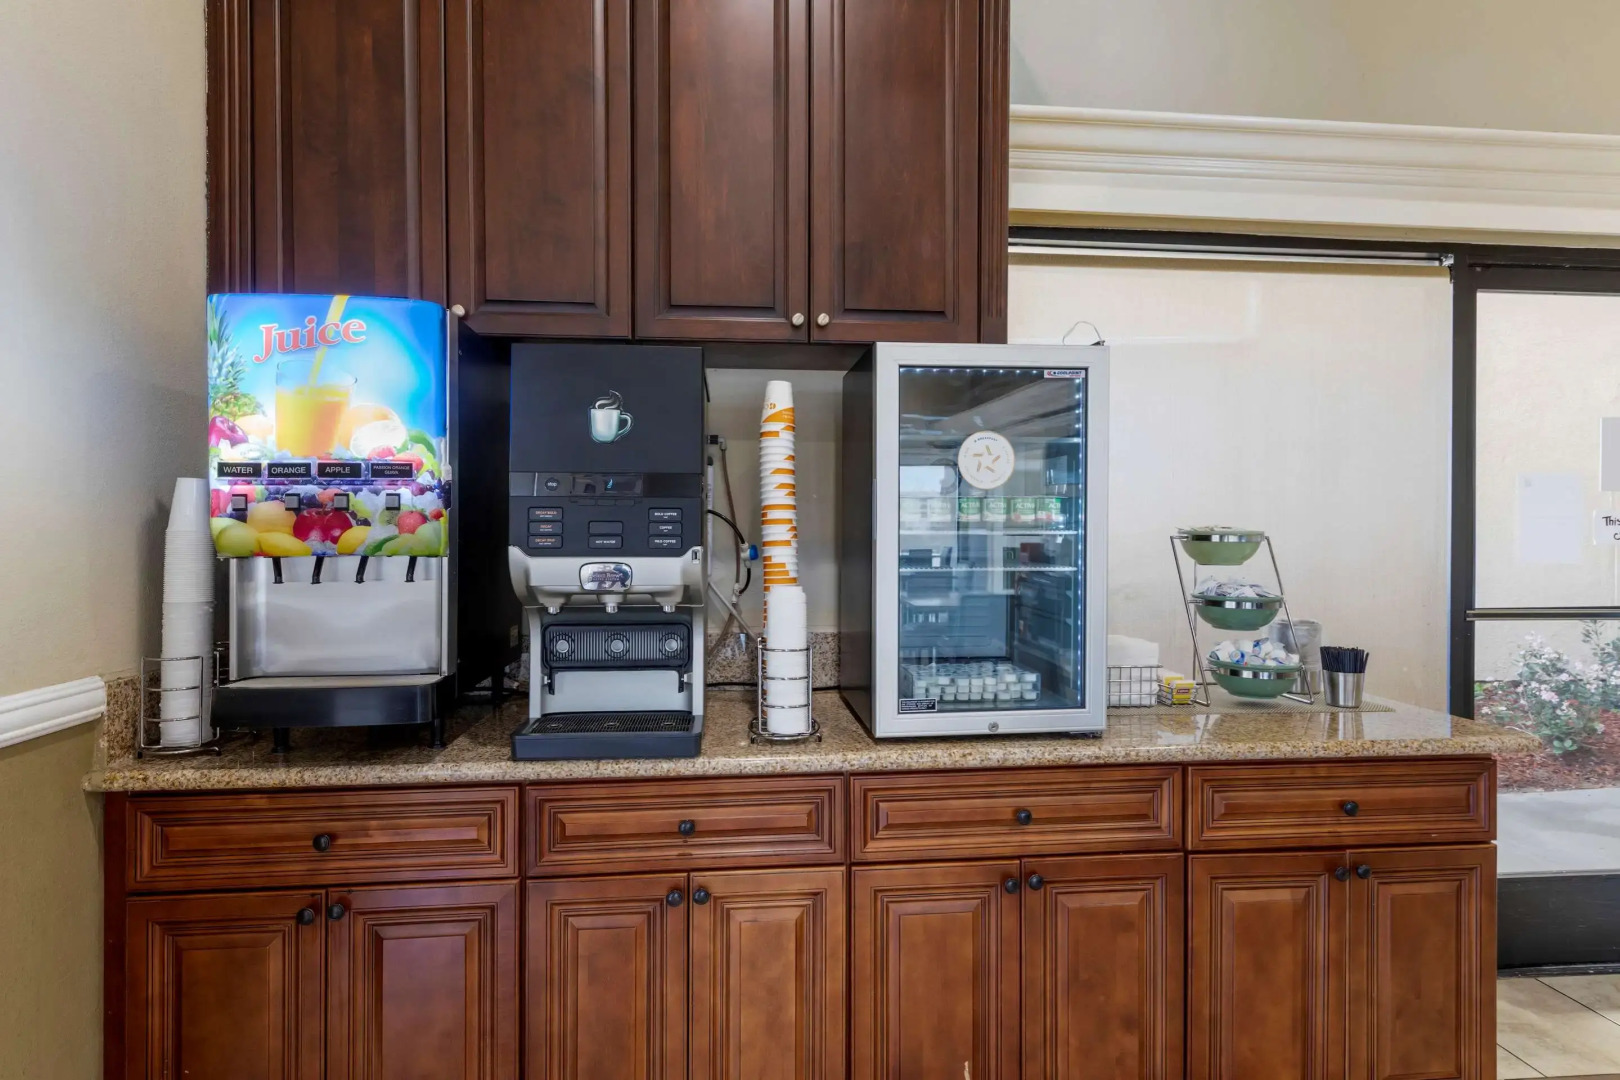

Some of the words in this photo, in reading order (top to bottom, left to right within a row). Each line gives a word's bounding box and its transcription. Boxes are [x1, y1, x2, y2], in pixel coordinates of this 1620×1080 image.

[252, 315, 366, 363] Juice
[223, 466, 253, 474] WATER
[271, 466, 307, 474] ORANGE
[325, 466, 351, 474] APPLE
